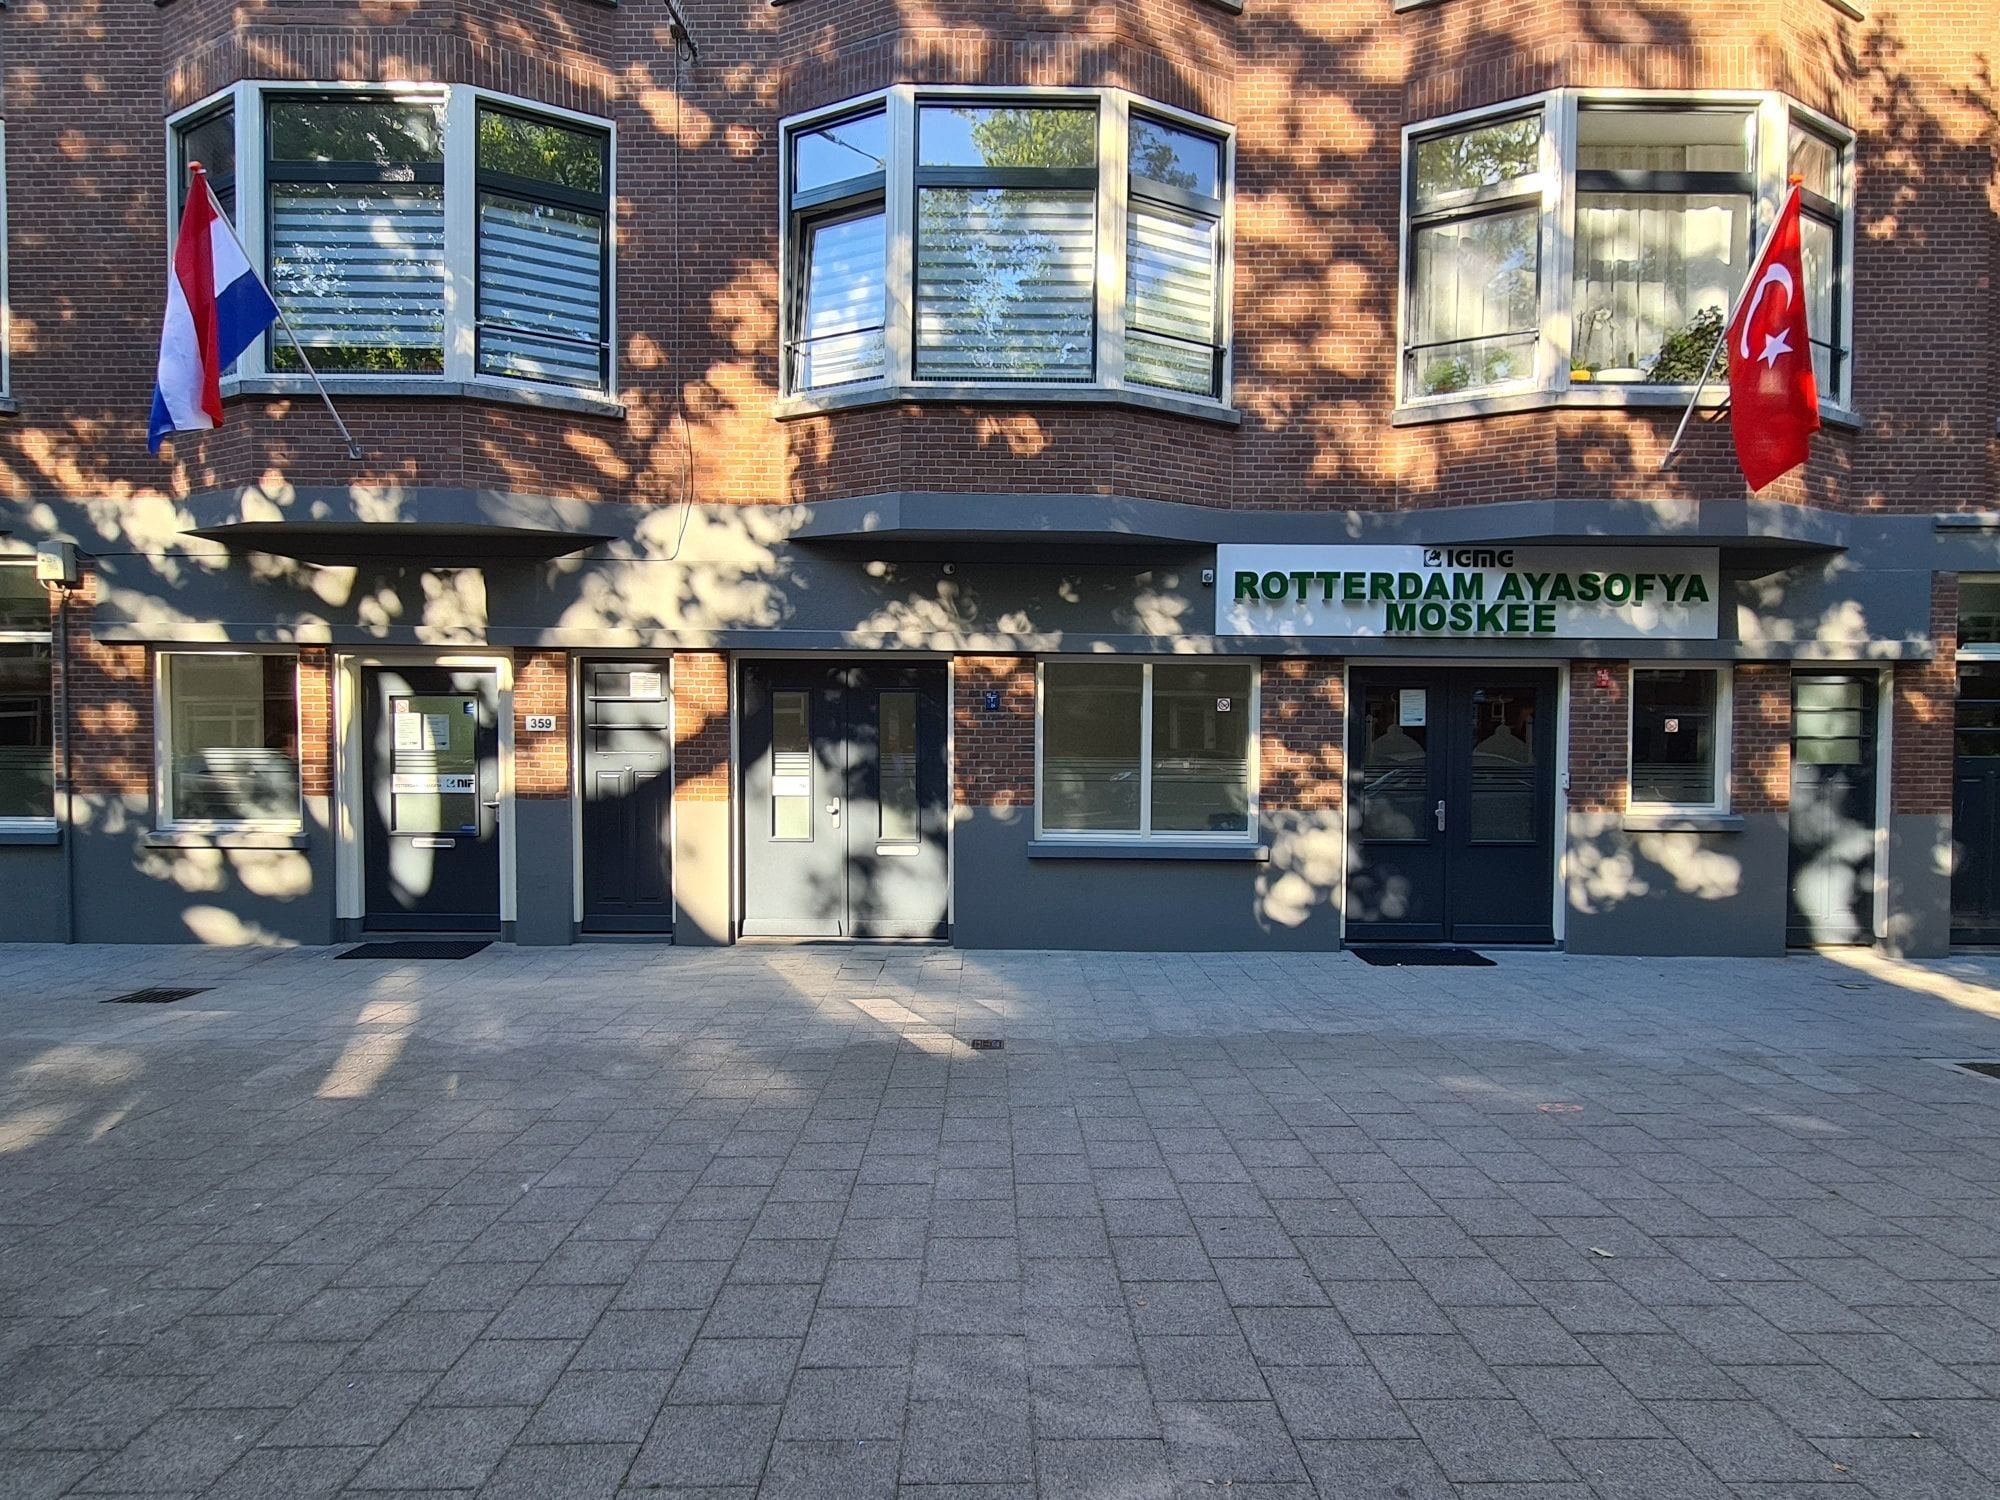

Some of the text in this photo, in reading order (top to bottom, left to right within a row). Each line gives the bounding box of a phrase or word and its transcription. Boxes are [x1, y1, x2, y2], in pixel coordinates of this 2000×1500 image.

[1447, 549, 1514, 568] IGMG
[1234, 571, 1710, 602] ROTTERDAM AYASOFYA
[1385, 602, 1556, 632] MOSKEE
[530, 718, 552, 728] 359
